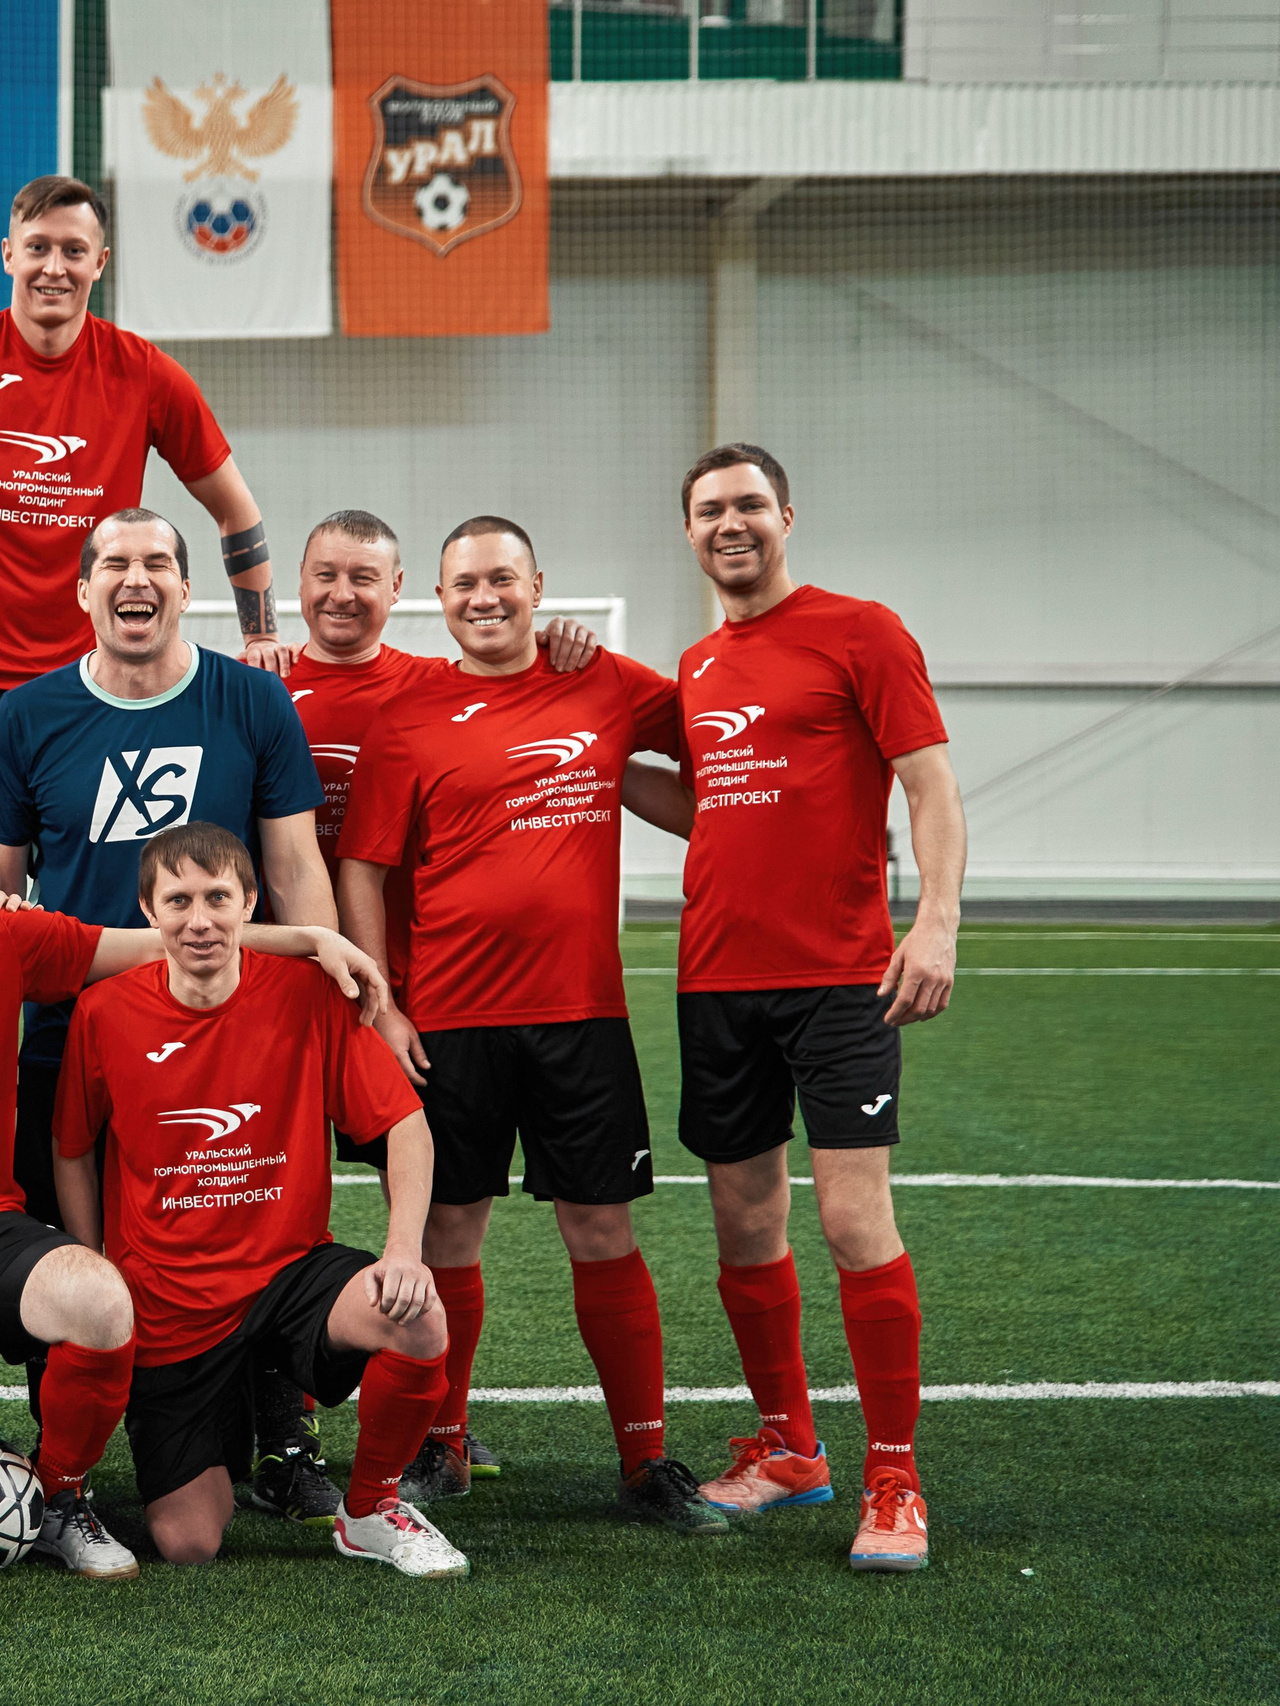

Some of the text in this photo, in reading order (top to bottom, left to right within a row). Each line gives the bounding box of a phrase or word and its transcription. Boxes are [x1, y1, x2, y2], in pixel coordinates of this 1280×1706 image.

[384, 117, 497, 185] УРАЛ
[12, 469, 71, 483] УРАЛЬСКИЙ
[18, 495, 66, 508] ХОЛДИНГ
[702, 745, 754, 762] УРАЛЬСКИЙ
[534, 766, 596, 788] УРАЛЬСКИЙ
[707, 774, 750, 788] ХОЛДИНГ
[546, 794, 595, 808] ХОЛДИНГ
[510, 809, 611, 831] ИНВЕСТПРОЕКТ
[185, 1143, 252, 1160] УРАЛЬСКИЙ
[154, 1151, 287, 1177] ГОРНОПРОМЫШЛЕННЫЙ
[197, 1174, 250, 1187] ХОЛДИНГ
[162, 1187, 283, 1210] ИНВЕСТПРОЕКТ
[624, 1419, 663, 1432] Joma
[871, 1442, 911, 1453] Joma
